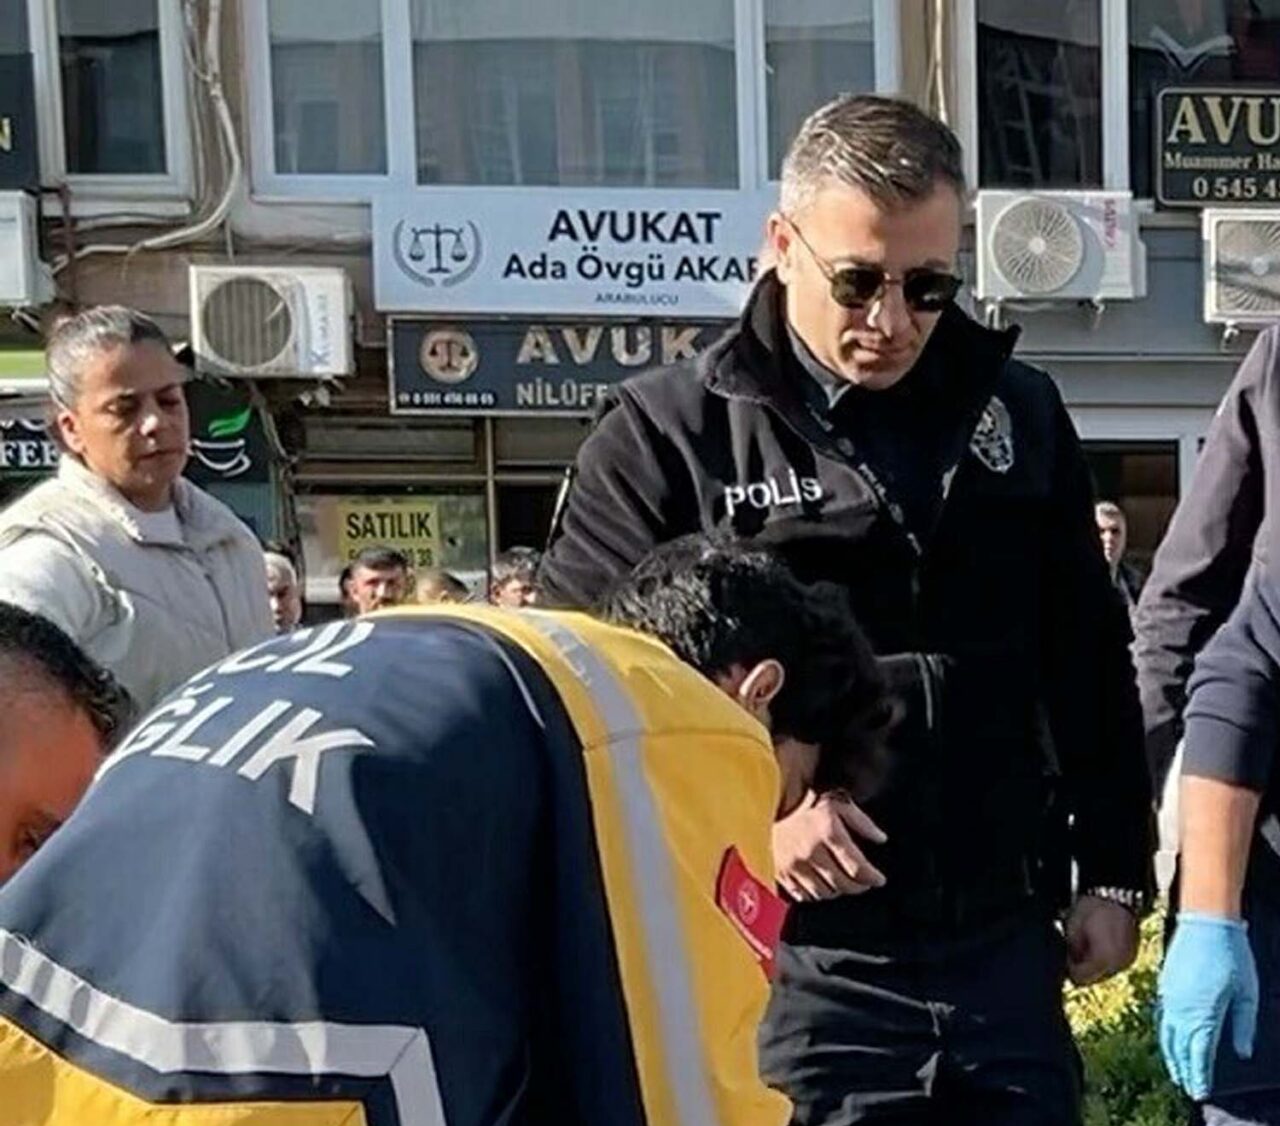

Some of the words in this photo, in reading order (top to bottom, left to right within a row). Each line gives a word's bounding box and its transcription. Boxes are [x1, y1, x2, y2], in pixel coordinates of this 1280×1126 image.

[1193, 178, 1208, 199] 0
[1214, 178, 1257, 199] 545
[548, 209, 723, 244] AVUKAT
[503, 253, 567, 280] Ada
[577, 246, 665, 288] Övgü
[346, 512, 432, 539] SATILIK
[95, 682, 376, 815] ĞLIK
